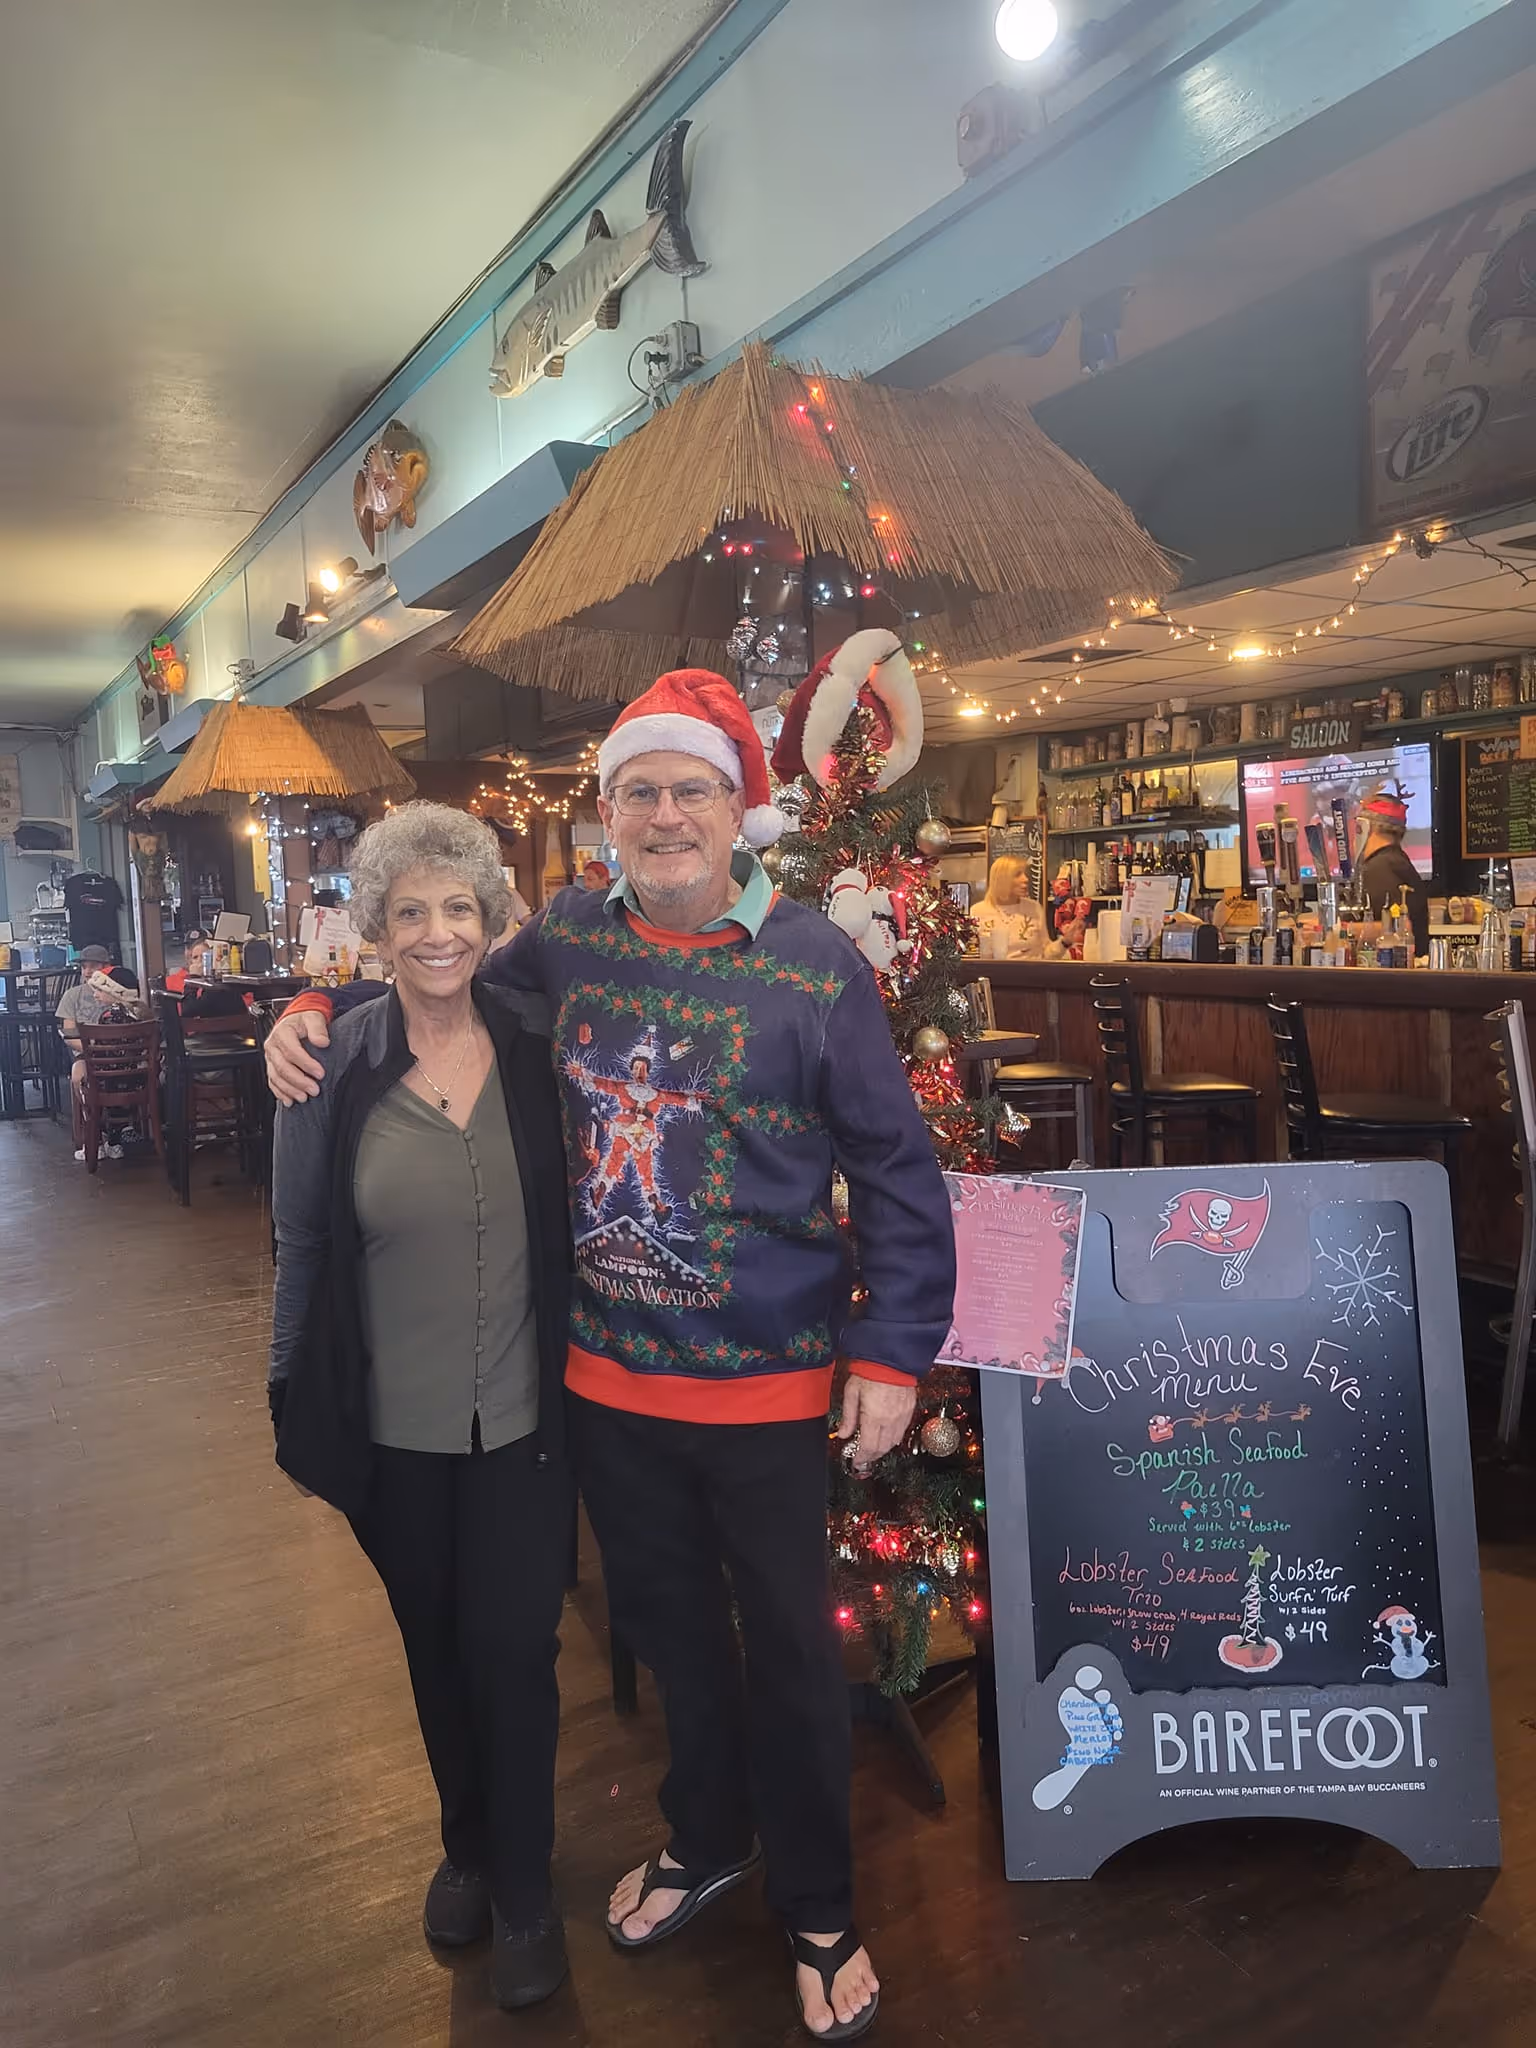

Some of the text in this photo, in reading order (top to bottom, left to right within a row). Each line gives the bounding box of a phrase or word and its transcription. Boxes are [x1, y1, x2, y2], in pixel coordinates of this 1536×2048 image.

[1290, 720, 1350, 749] SALOON
[1334, 810, 1348, 861] BUD LIGHT
[609, 1254, 647, 1266] NATIONAL
[636, 1279, 721, 1310] VACATION
[1068, 1314, 1362, 1413] Christmas Eve
[1106, 1427, 1308, 1480] Spanish Seafood
[1161, 1469, 1265, 1504] Paella
[1199, 1499, 1236, 1519] $39
[1148, 1517, 1188, 1533] Served
[1193, 1520, 1224, 1532] with
[1194, 1537, 1204, 1552] 2
[1210, 1537, 1246, 1550] sides
[1058, 1545, 1149, 1584] Lobster
[1270, 1554, 1344, 1582] Lobster
[1121, 1583, 1162, 1607] Trio
[1320, 1584, 1357, 1603] Turf
[1180, 1609, 1187, 1621] 4
[1292, 1607, 1298, 1615] 2
[1130, 1620, 1139, 1630] 2
[1131, 1634, 1171, 1659] $49
[1152, 1705, 1429, 1774] BAREFOOT
[1159, 1781, 1426, 1797] AN OFFICIAL WINE PARTNER OF THE TAMPA BAY BUCCANEERS
